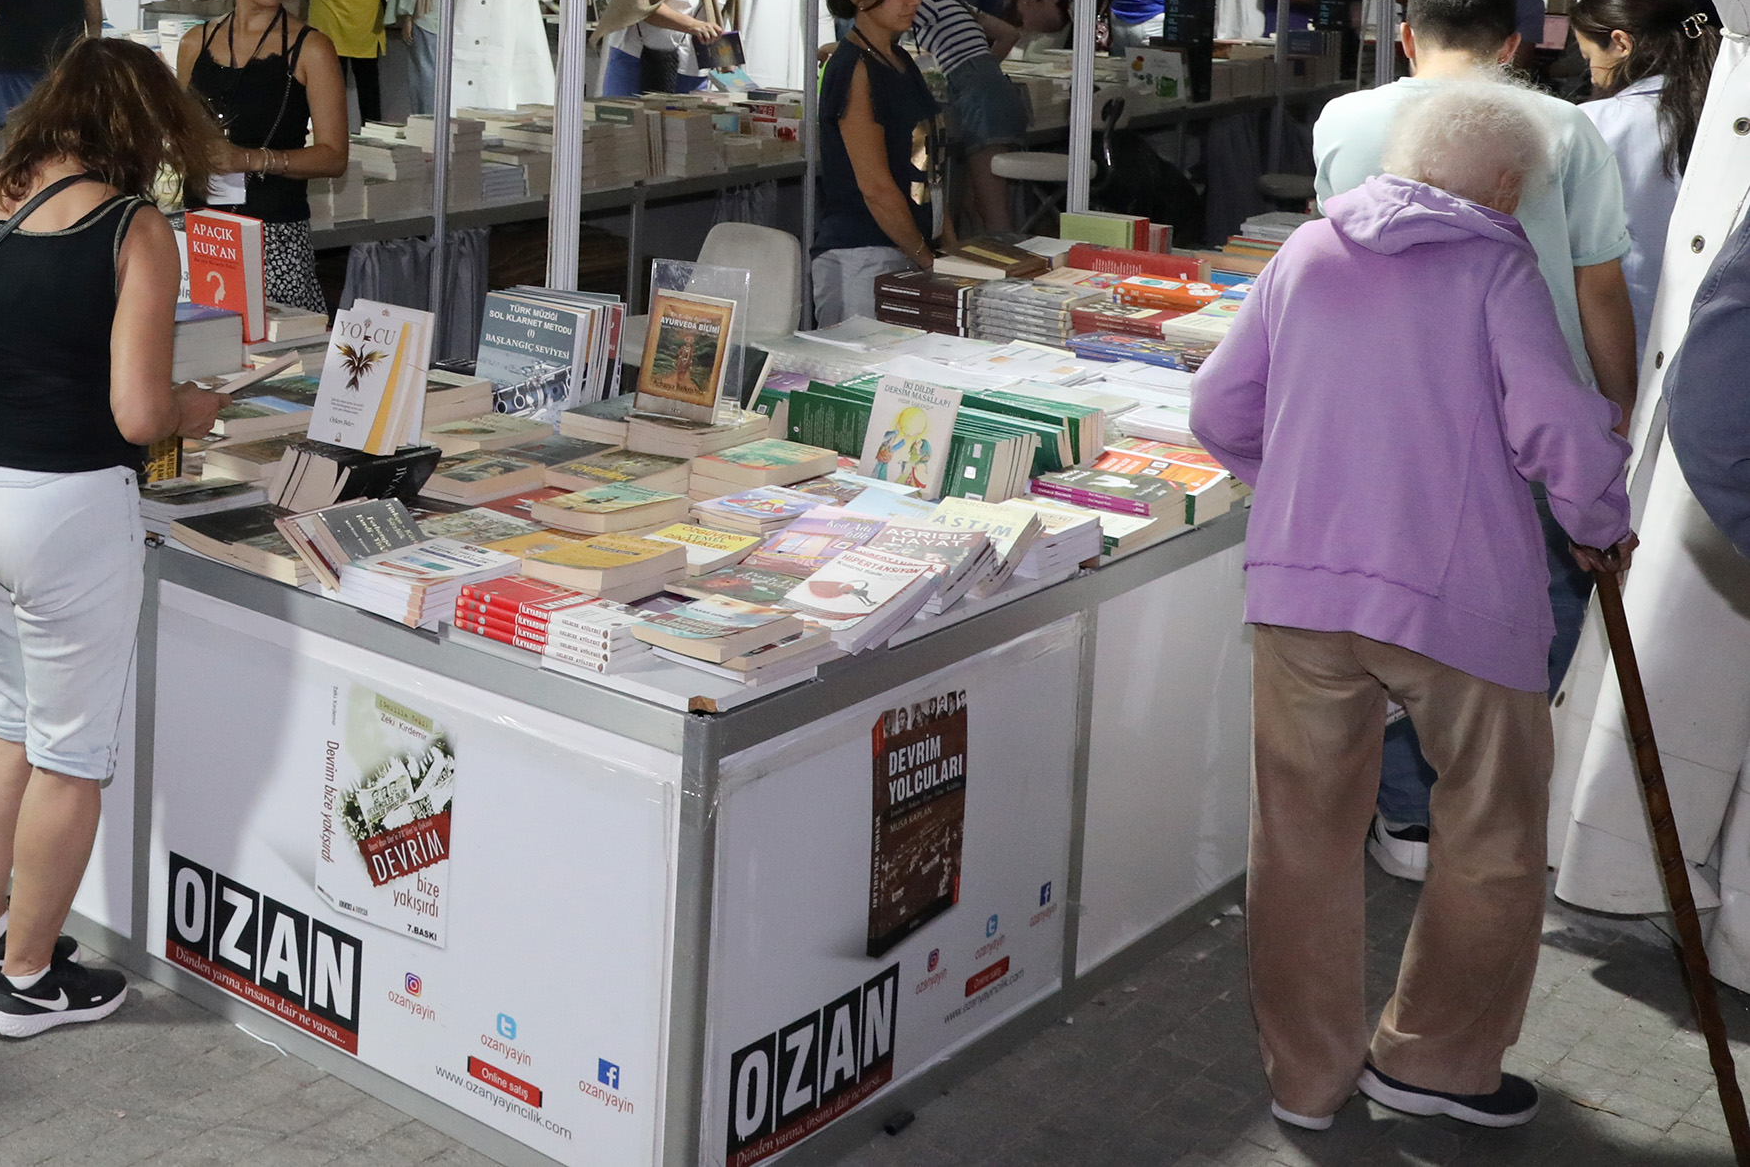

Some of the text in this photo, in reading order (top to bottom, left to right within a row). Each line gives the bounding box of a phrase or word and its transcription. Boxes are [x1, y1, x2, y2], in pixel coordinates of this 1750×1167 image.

[192, 223, 234, 242] APAÇIK
[192, 241, 236, 260] KUR'AN
[489, 310, 573, 335] SOL KLARNET METODU
[510, 304, 558, 322] TÜRK MÜZİĞİ
[661, 316, 721, 334] AYURVEDA BİLİMİ
[340, 318, 396, 345] YOLCU
[485, 334, 570, 360] BAŞLANGIÇ SEVİYESİ
[884, 384, 911, 400] DERSİM
[912, 390, 951, 408] MASALLARI
[915, 382, 936, 396] DİLDE
[682, 525, 746, 542] ÖZGÜVENİN
[687, 533, 726, 544] TEMEL
[886, 527, 973, 541] AĞRISIZ
[932, 514, 1012, 538] ASTIM
[664, 534, 730, 550] DİNAMİKLERİ
[891, 537, 965, 547] HAYAT
[842, 554, 922, 574] HİPERTANSİYON
[518, 615, 546, 631] İLKYARDIM
[521, 604, 549, 620] İLKYARDIM
[515, 637, 543, 654] İLKYARDIM
[518, 626, 546, 642] İLKYARDIM
[381, 713, 395, 727] Zeki
[399, 720, 428, 740] Kırdemir
[889, 734, 941, 776] DEVRİM
[889, 753, 963, 805] YOLCULARI
[321, 741, 339, 863] Devrim bize yakışırdı
[372, 829, 445, 883] DEVRİM
[416, 873, 440, 898] bize
[393, 889, 439, 918] yakışırdı
[174, 866, 356, 1021] OZAN
[407, 924, 438, 941] 7.BASKI
[974, 934, 1006, 960] ozanyayin
[915, 967, 948, 995] ozanyayin
[175, 945, 347, 1044] Dünden yarına, insana dair ne varsa...
[388, 989, 436, 1021] ozanyayin
[480, 1032, 532, 1067] ozanyayin
[735, 975, 895, 1142] OZAN
[481, 1066, 530, 1100] Online satış
[435, 1064, 572, 1140] www.ozanyayincilik.com
[579, 1078, 635, 1115] ozanyayin
[736, 1139, 774, 1167] Dünden
